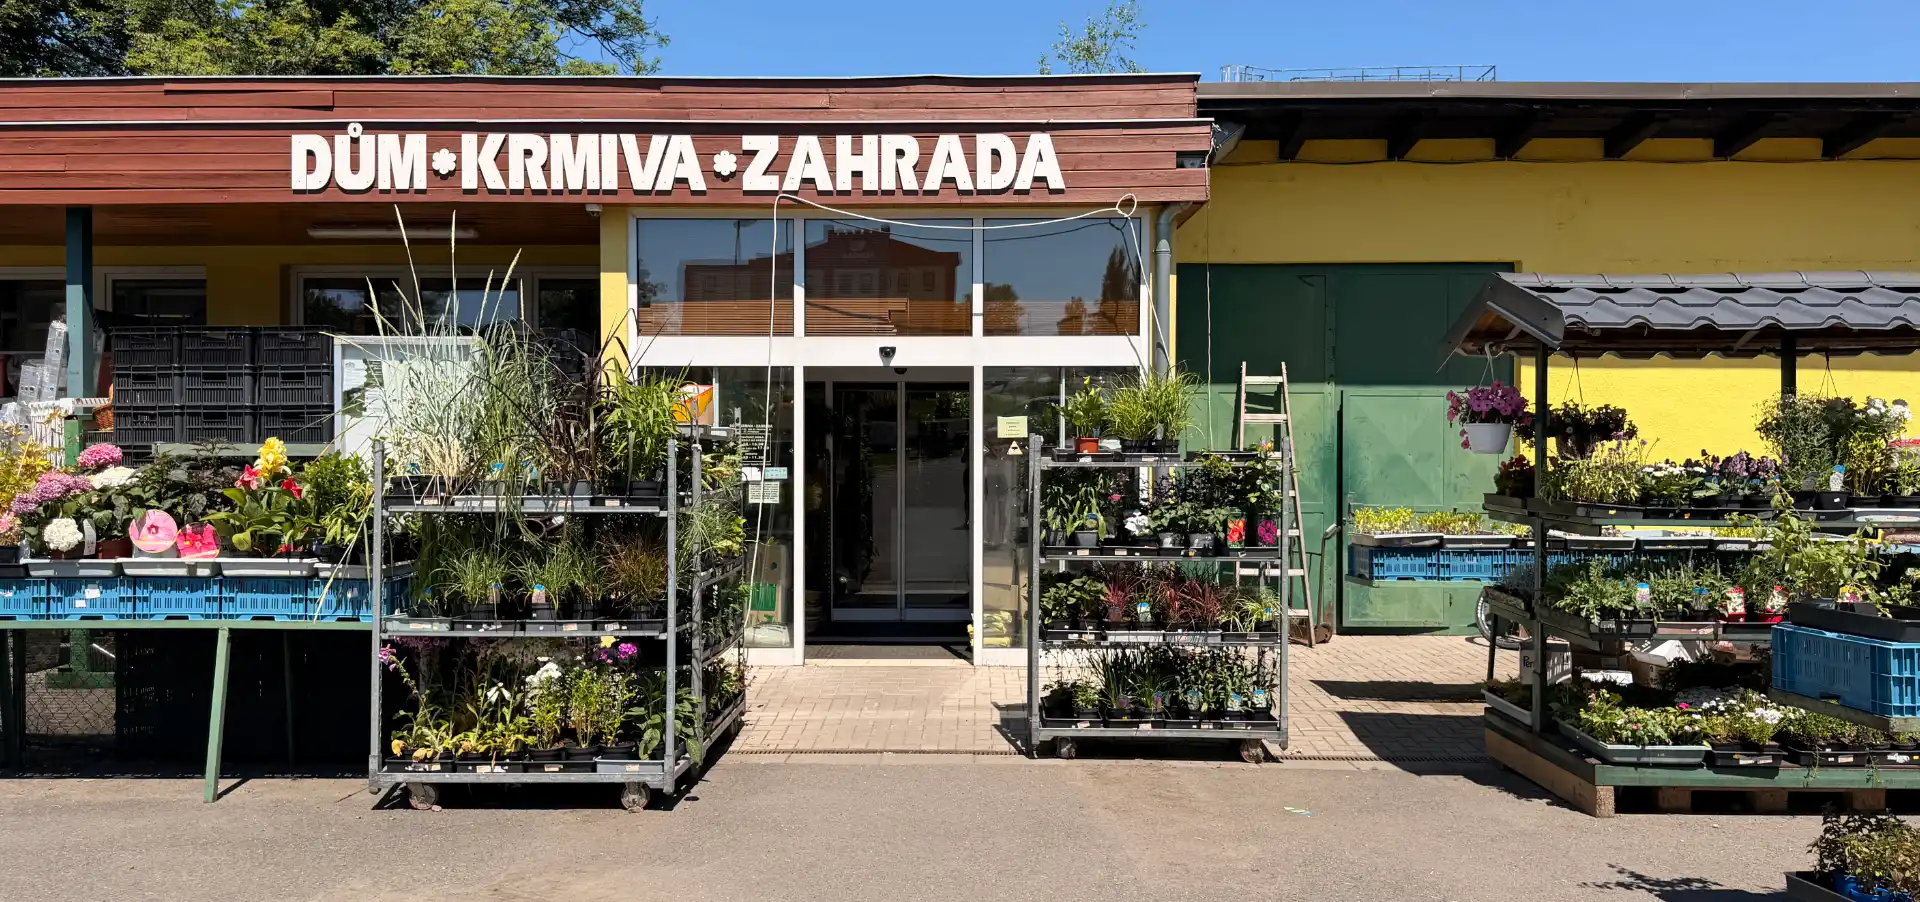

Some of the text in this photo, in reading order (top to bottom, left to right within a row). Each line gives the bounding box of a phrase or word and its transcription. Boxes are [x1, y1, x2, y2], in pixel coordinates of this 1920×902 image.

[291, 122, 1066, 191] DŮM KRMIVA ZAHRADA
